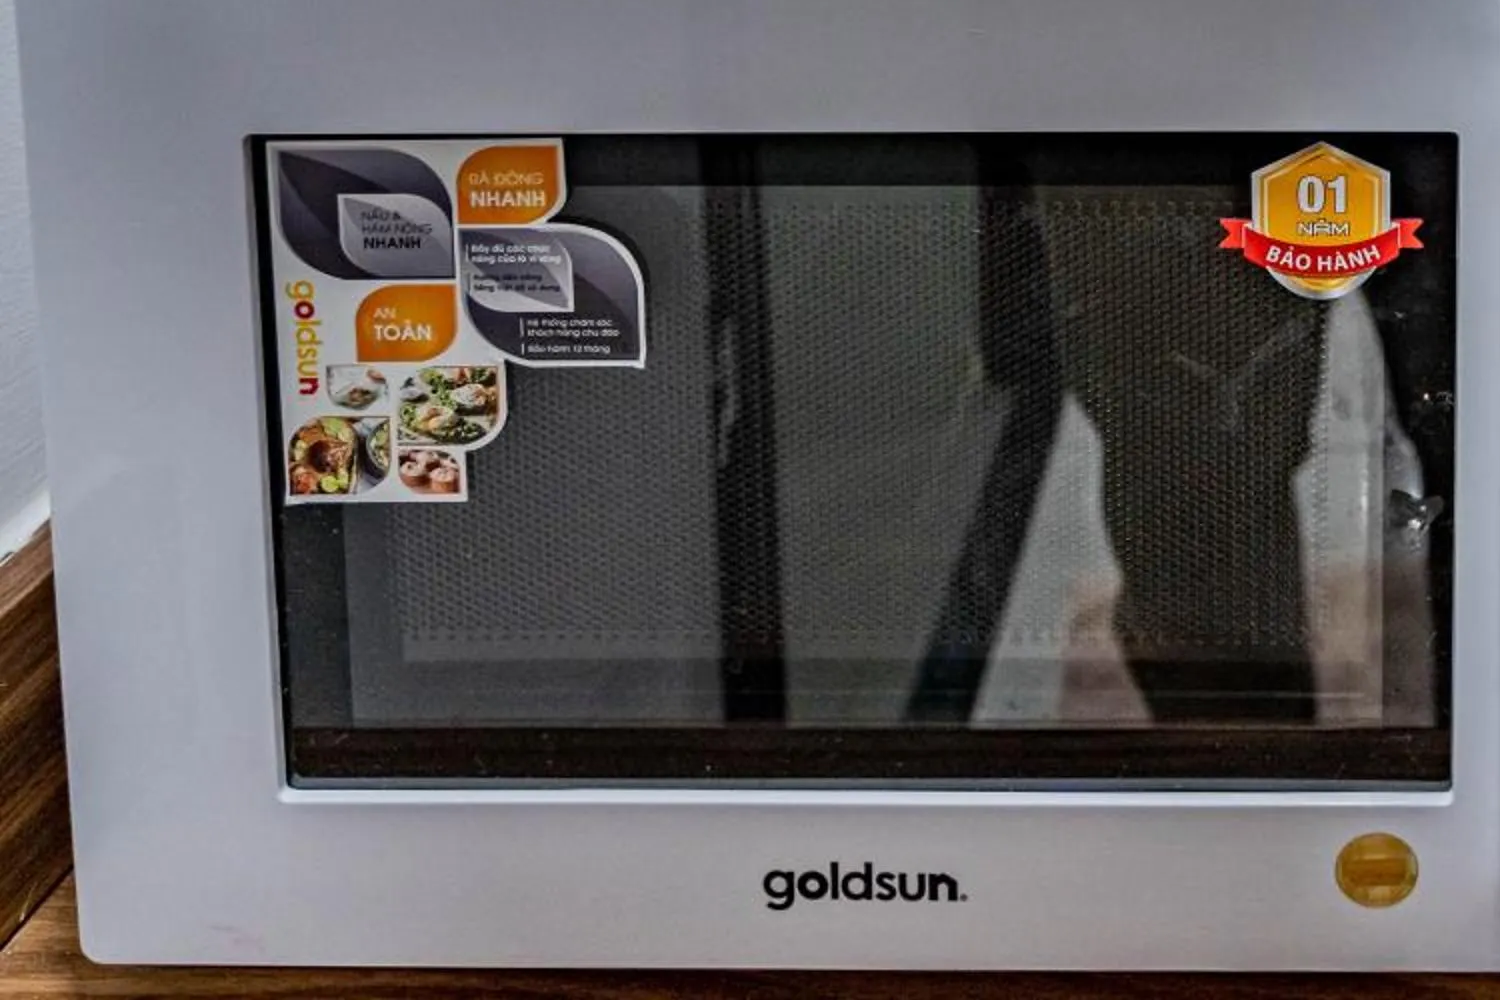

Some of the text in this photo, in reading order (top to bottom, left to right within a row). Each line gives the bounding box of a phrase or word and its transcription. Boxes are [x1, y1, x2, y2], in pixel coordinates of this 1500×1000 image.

[471, 189, 546, 208] NHANH
[1297, 175, 1348, 214] 01
[363, 236, 421, 249] NHANH
[1266, 244, 1381, 272] BẢO HÀNH
[373, 307, 396, 319] AN
[285, 280, 322, 396] goldsun
